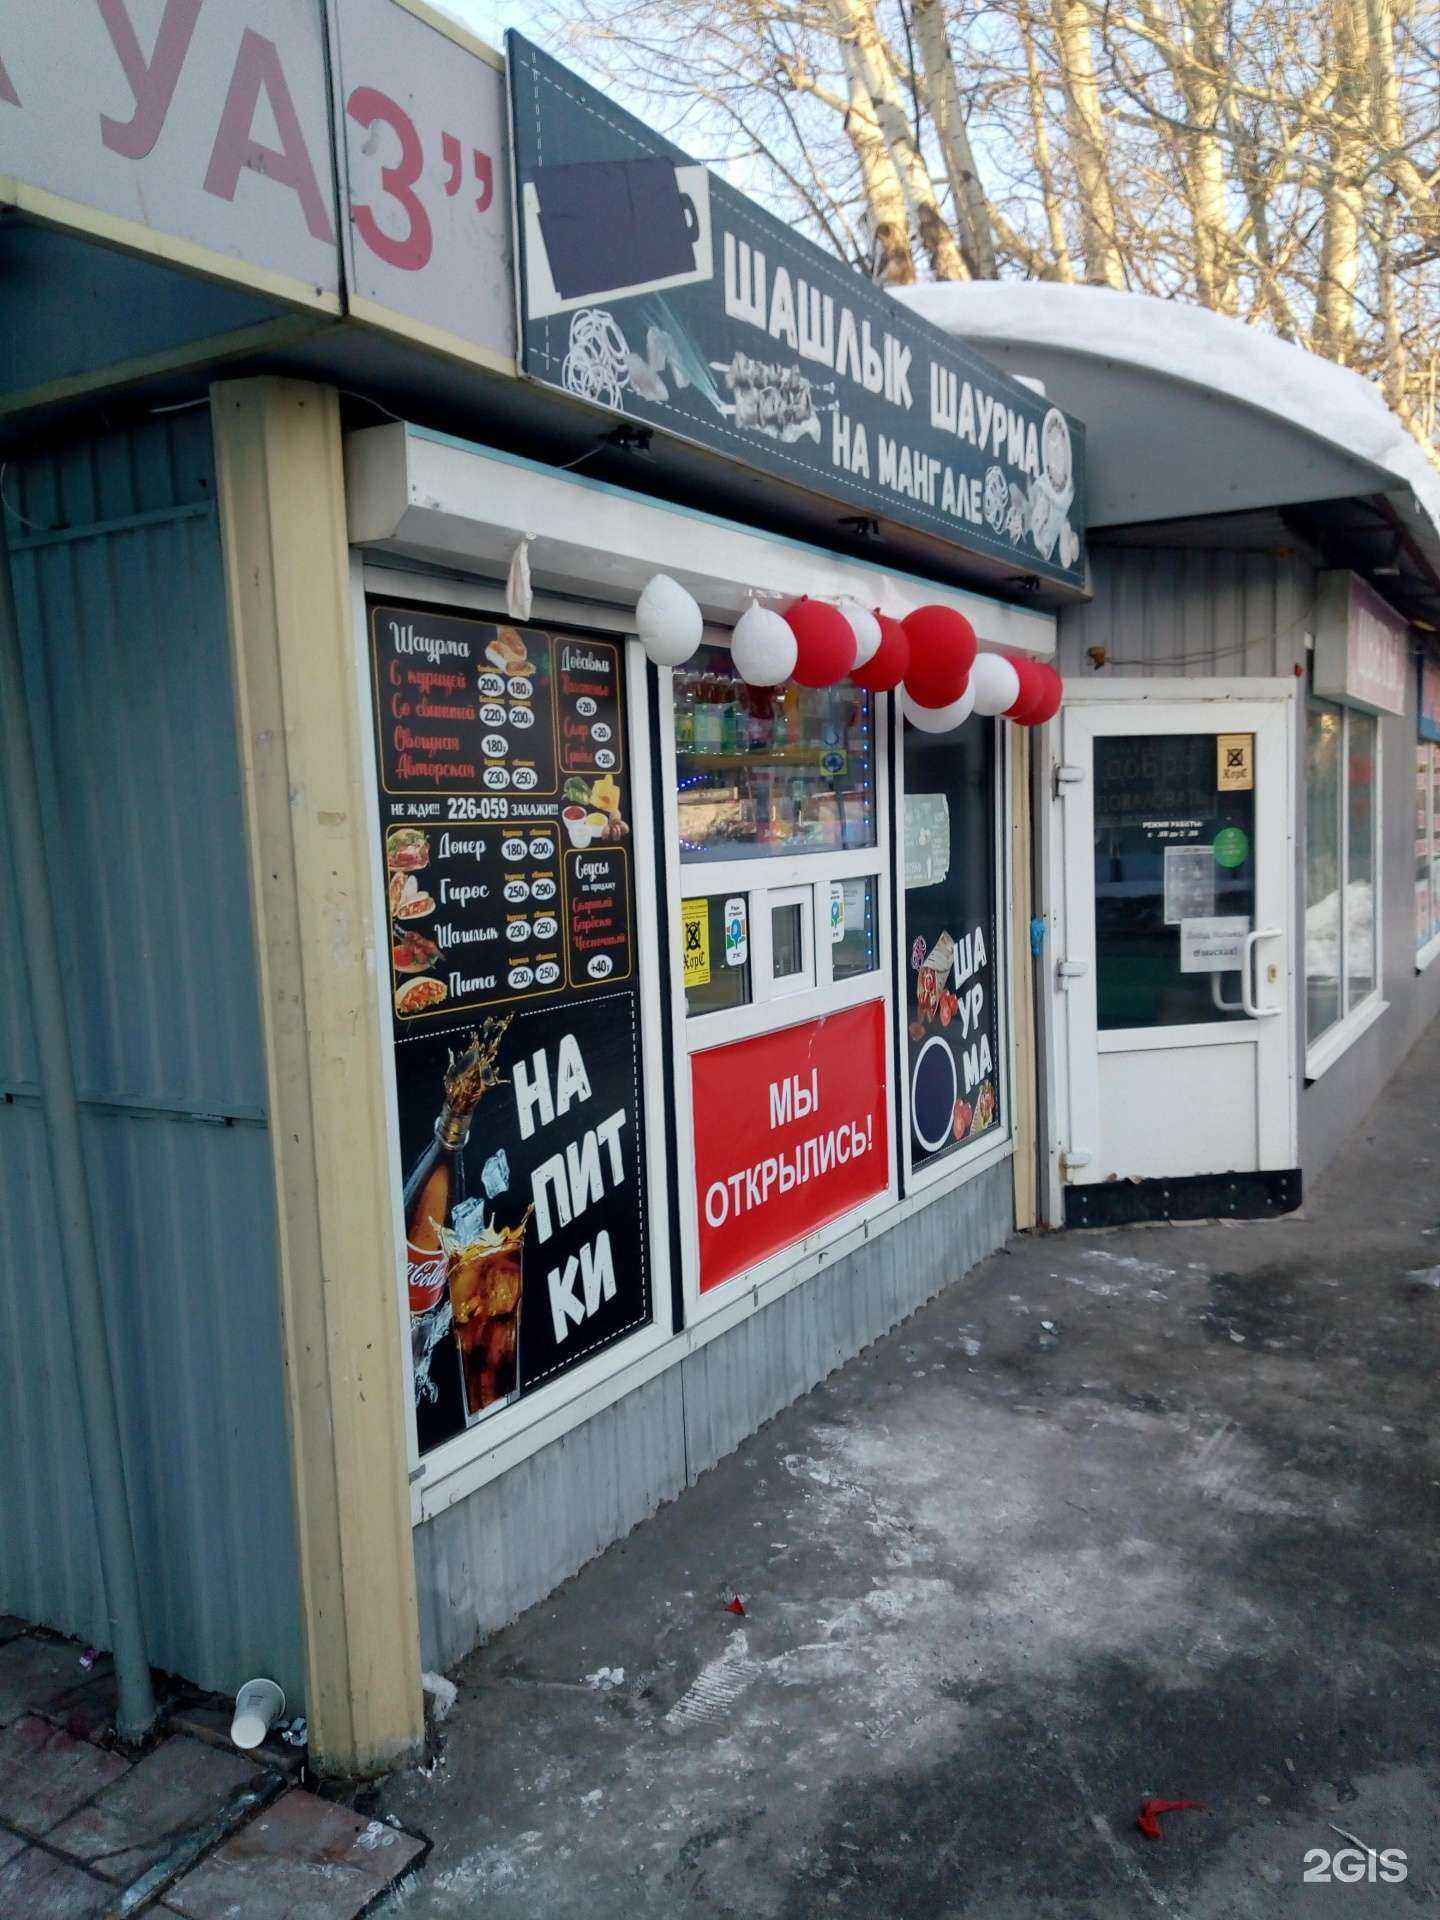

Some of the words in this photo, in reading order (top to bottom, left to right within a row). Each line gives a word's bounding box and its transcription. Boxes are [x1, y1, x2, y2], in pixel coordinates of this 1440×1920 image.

[723, 231, 912, 410] ШАШЛЫК
[930, 362, 1041, 477] ШАУРМА
[832, 412, 869, 479] НА
[878, 434, 984, 525] МАНГАЛЕ
[389, 621, 471, 664] Шаурма
[391, 803, 405, 815] НЕ
[407, 803, 440, 817] ЖДИ!!!
[447, 798, 508, 819] 226-059
[510, 804, 559, 816] ЗАКАЖИ!!!
[438, 832, 486, 861] Донер
[576, 855, 609, 882] Соусы
[440, 878, 489, 908] Гирос
[434, 922, 499, 949] Шашлык
[953, 926, 987, 991] ША
[449, 971, 498, 998] Пита
[958, 982, 984, 1040] УР
[512, 1033, 592, 1141] НА
[963, 1033, 992, 1094] МА
[769, 1067, 819, 1130] МЫ
[530, 1108, 627, 1245] ПИТ
[705, 1113, 873, 1228] ОТКРЫЛИСЬ!
[547, 1229, 618, 1344] КИ
